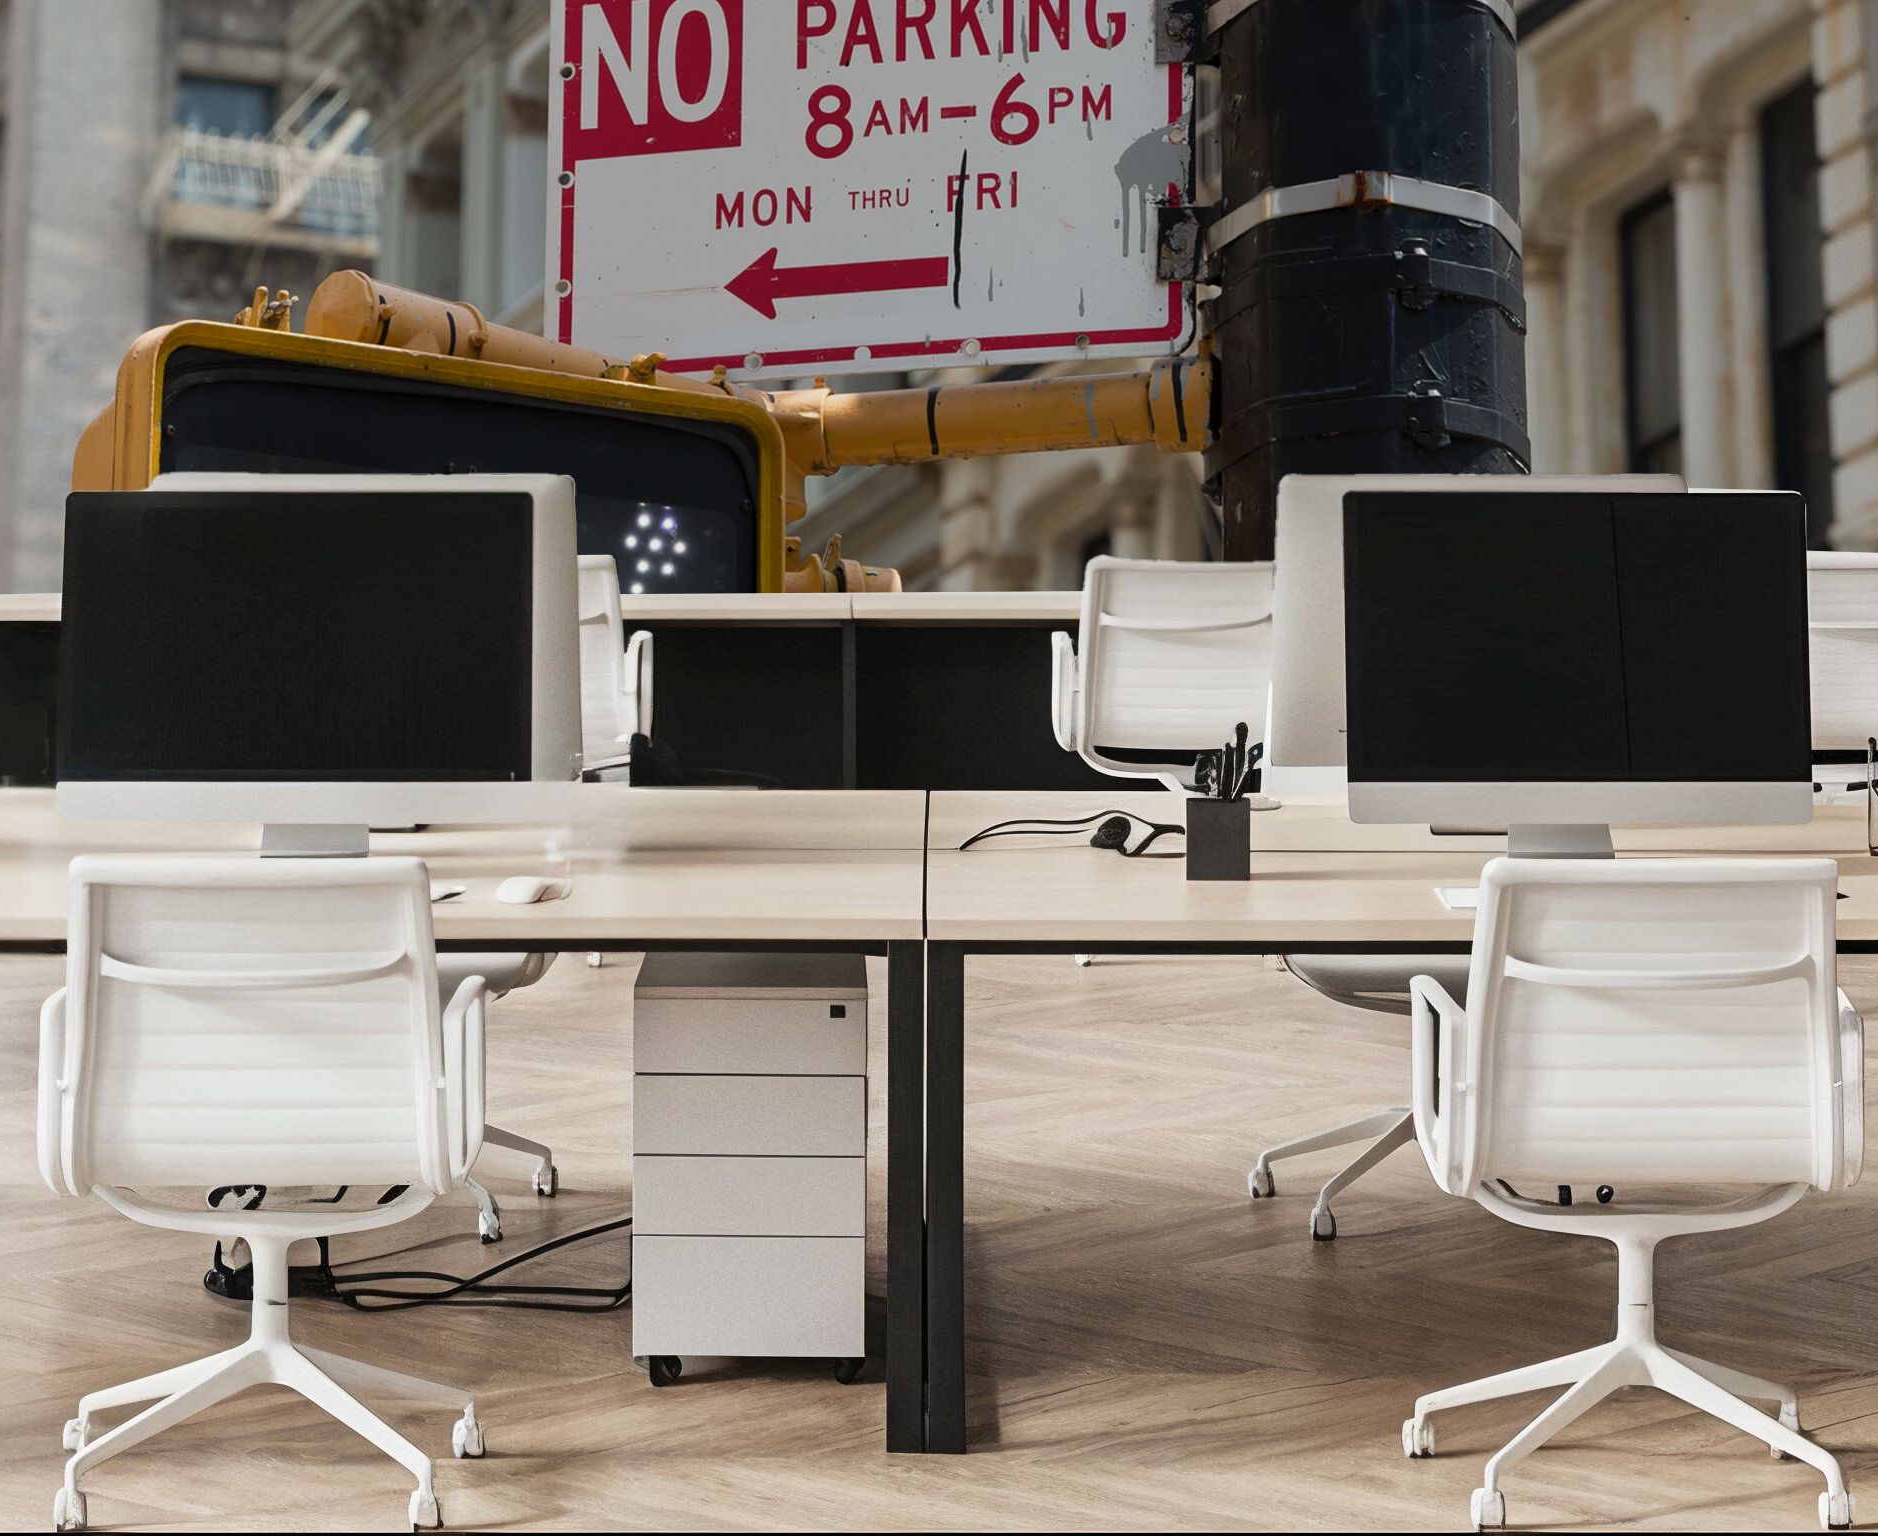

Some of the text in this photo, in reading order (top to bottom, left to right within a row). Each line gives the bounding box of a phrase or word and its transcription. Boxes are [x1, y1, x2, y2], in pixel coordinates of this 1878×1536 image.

[714, 170, 1019, 230] MON THRU FRI
